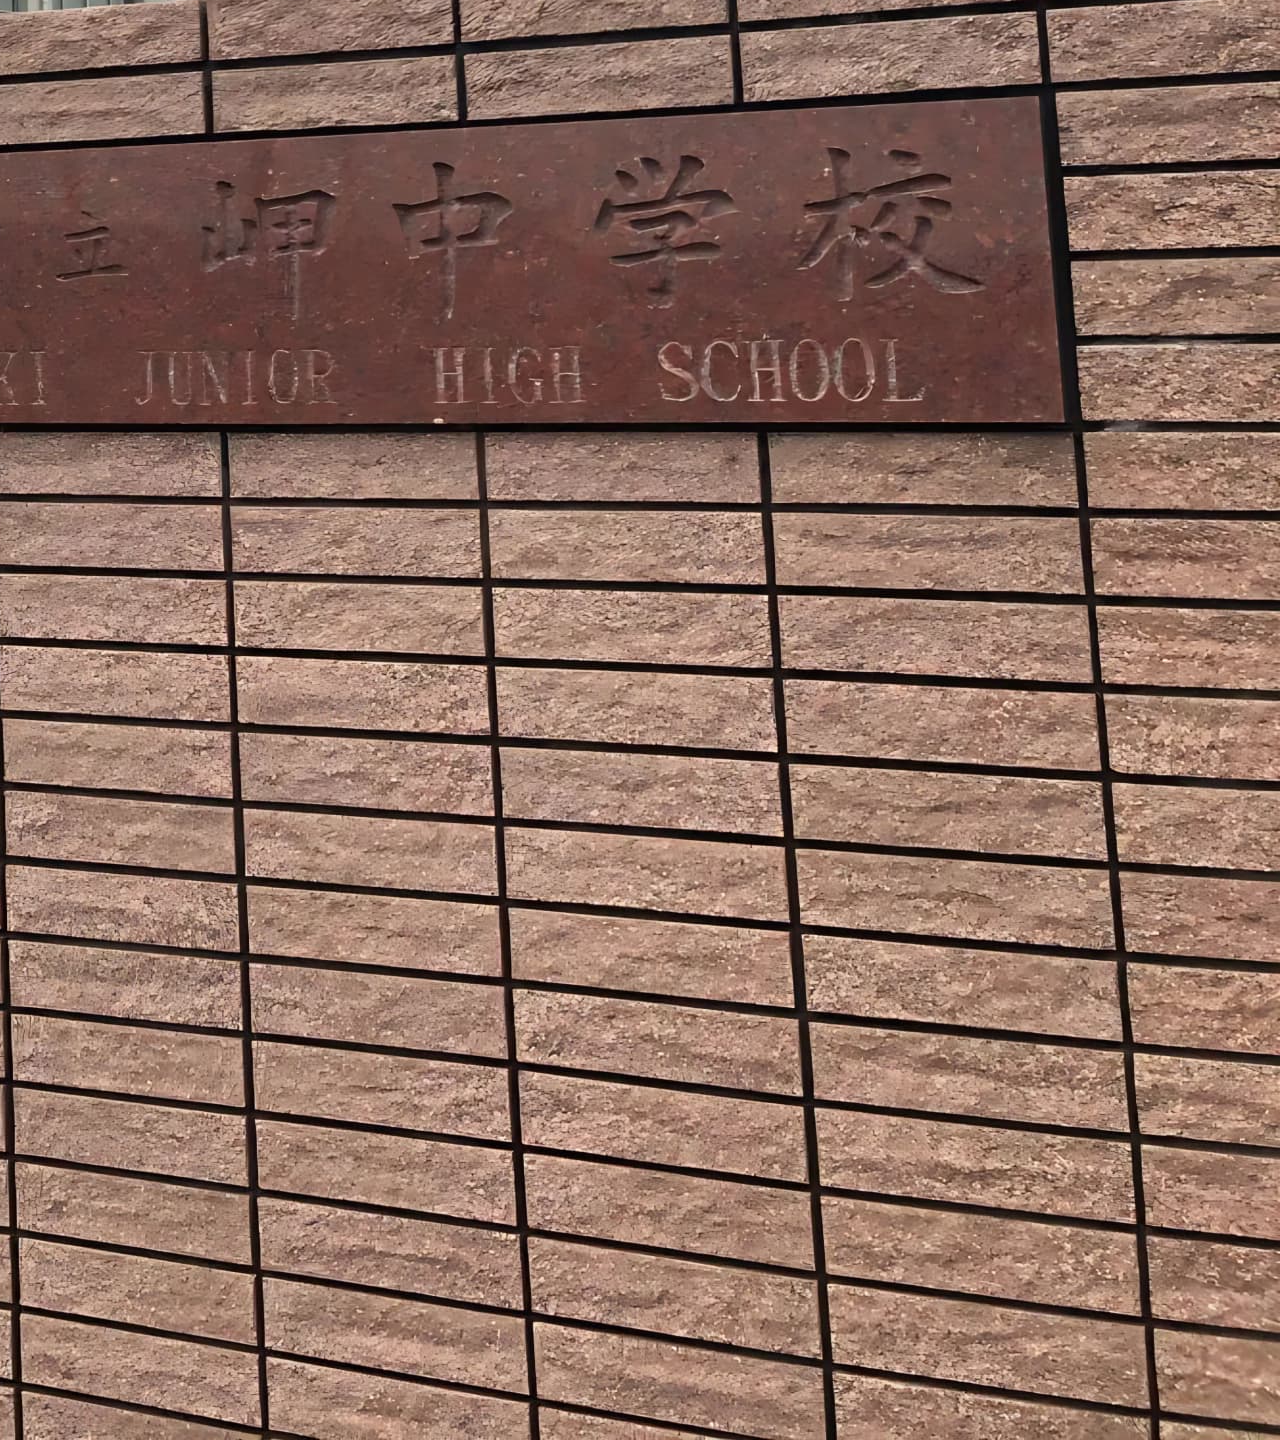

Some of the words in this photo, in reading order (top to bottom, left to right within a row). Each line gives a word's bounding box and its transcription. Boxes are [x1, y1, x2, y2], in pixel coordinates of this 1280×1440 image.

[135, 349, 338, 406] JUNIOR
[433, 346, 582, 405] HIGH
[657, 337, 928, 403] SCHOOL
